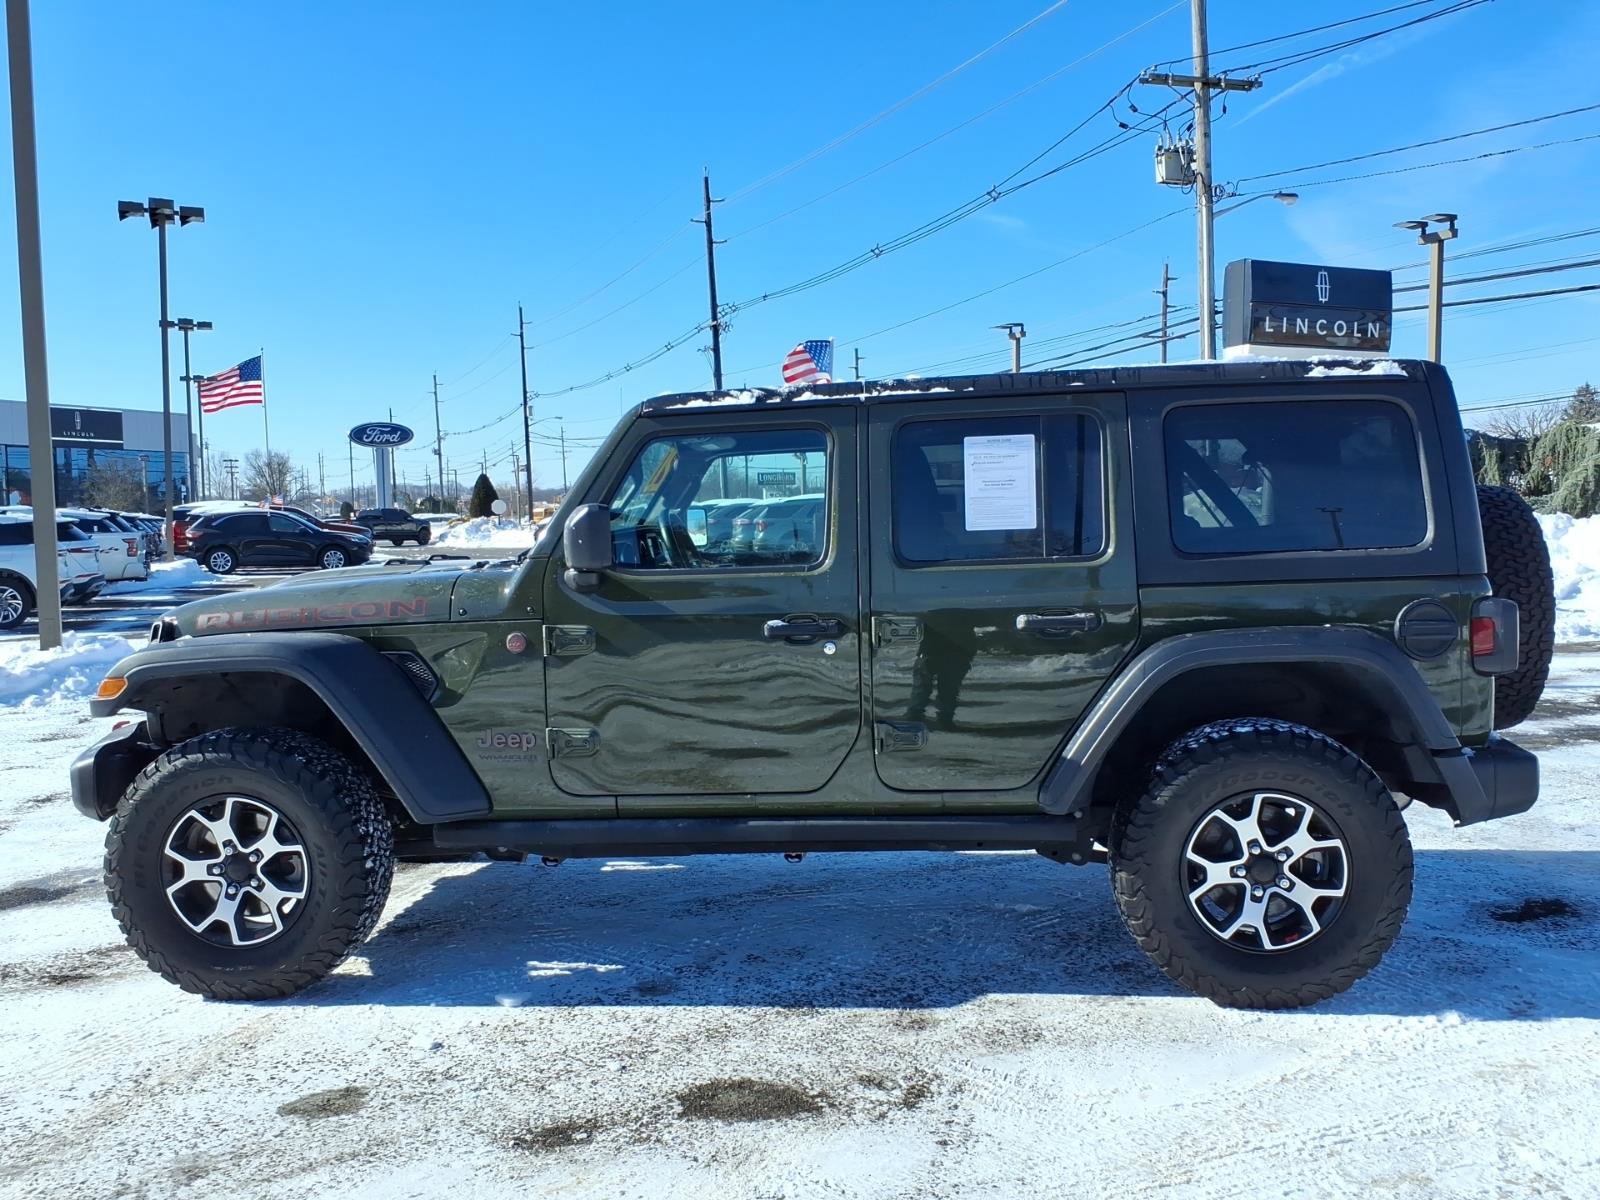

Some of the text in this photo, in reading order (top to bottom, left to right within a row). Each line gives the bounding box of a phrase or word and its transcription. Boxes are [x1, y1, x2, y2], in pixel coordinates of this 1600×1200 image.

[1264, 316, 1381, 338] LINCOLN
[363, 426, 402, 442] Ford
[196, 597, 429, 630] RUBICON
[477, 729, 536, 751] Jeep
